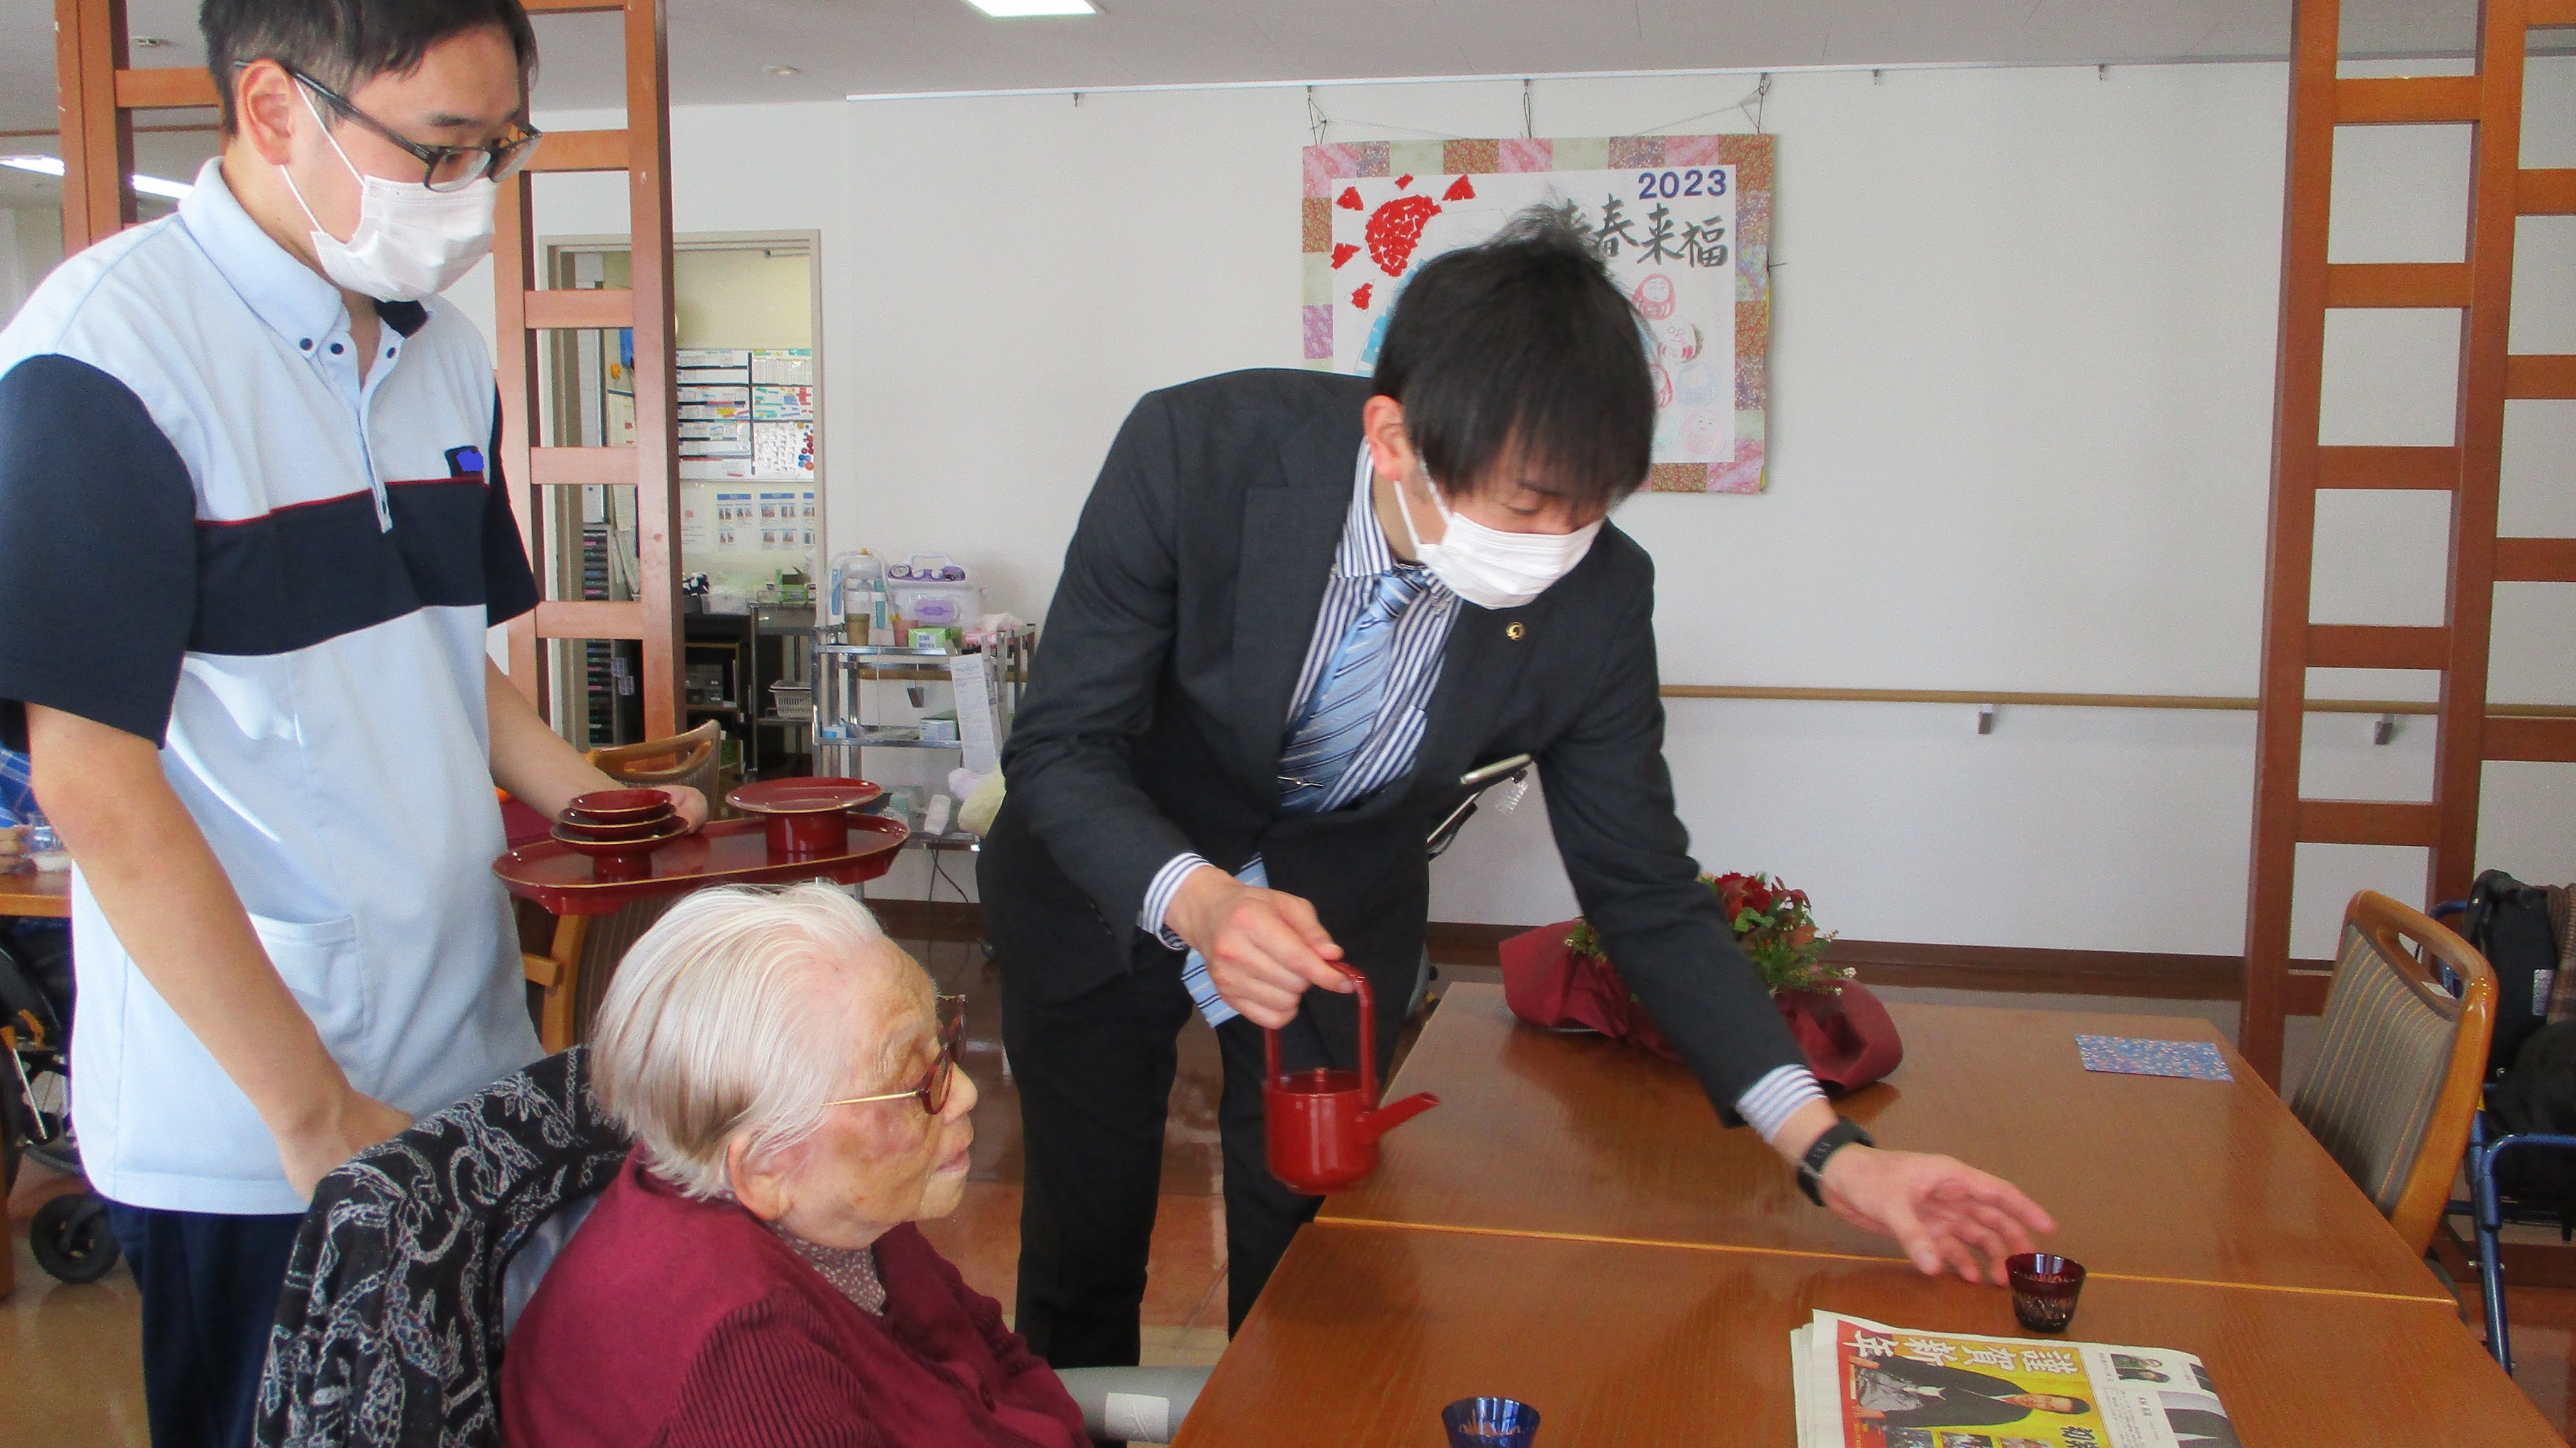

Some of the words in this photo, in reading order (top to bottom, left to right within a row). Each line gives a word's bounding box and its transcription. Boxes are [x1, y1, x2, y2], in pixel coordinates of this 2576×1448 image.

[1638, 169, 1727, 199] 2023
[1843, 1329, 2078, 1374] 謹賀新年
